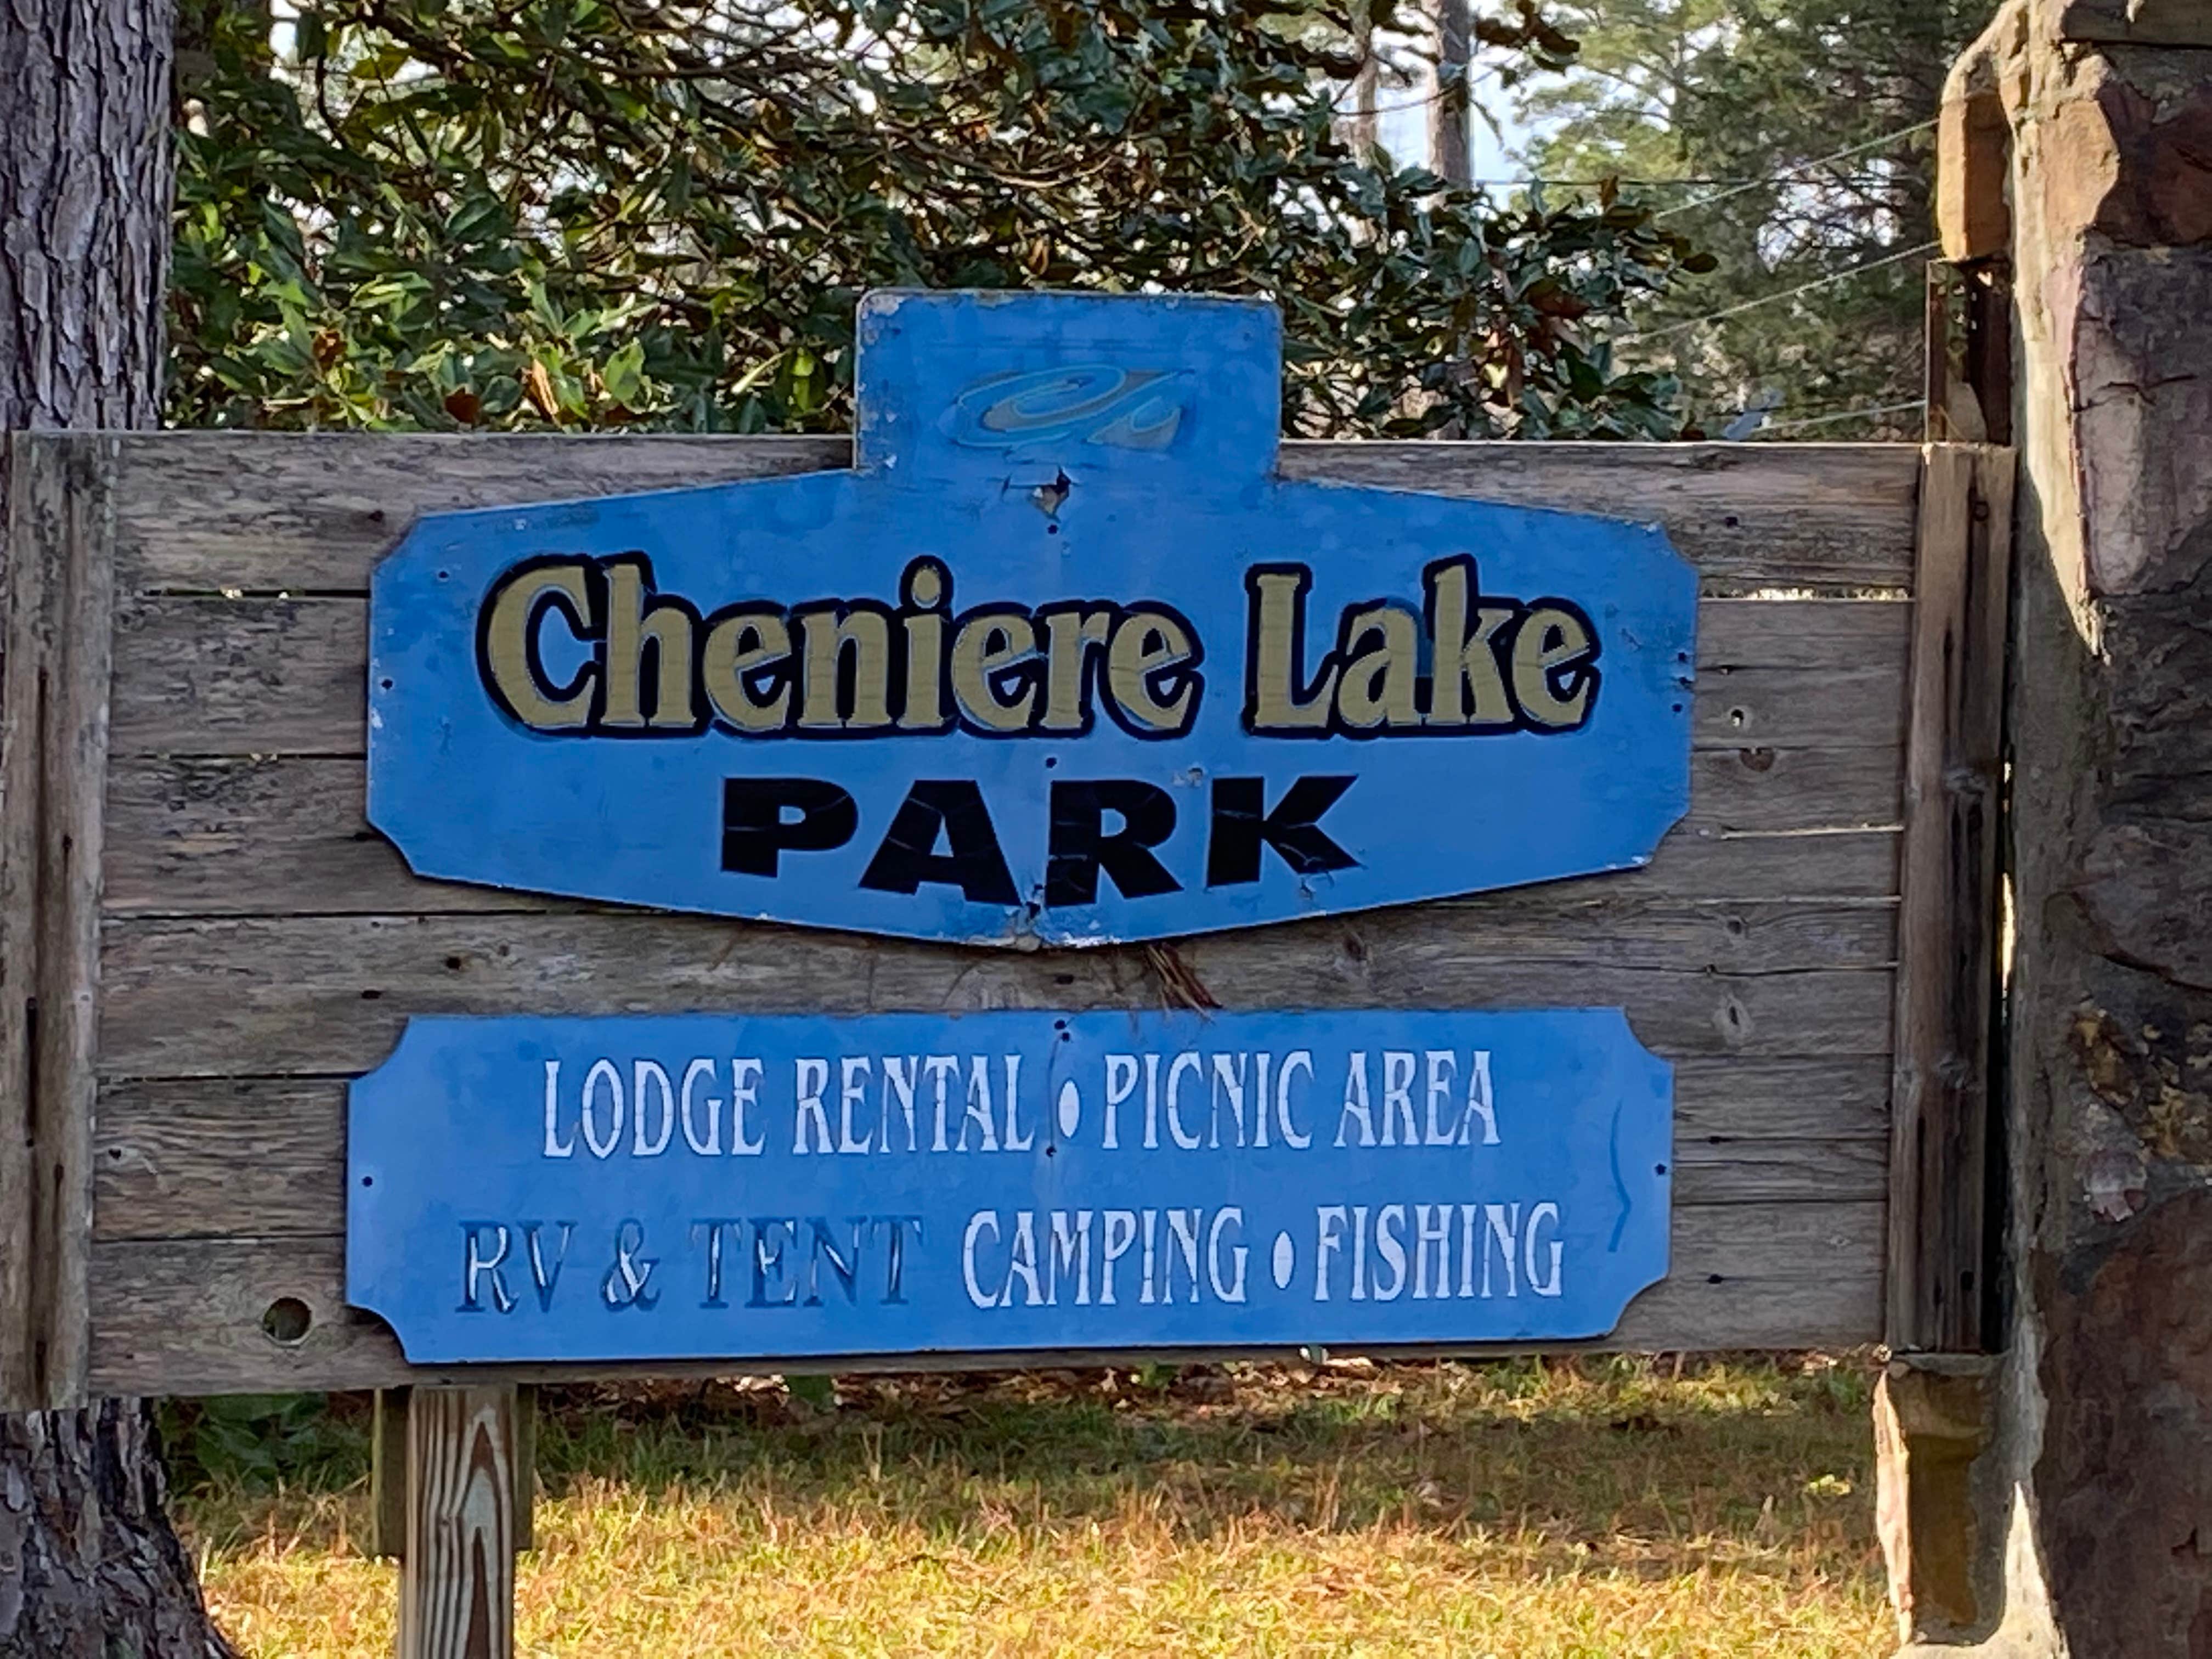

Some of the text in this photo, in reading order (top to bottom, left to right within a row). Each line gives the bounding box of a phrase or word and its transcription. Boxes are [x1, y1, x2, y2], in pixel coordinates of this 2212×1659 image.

[476, 551, 1601, 738] Cheniere Lake
[721, 775, 1358, 907] PARK
[543, 1049, 1501, 1159] LODGE RENTAL PICNIC AREA
[455, 1201, 1563, 1313] RV & TENT CAMPING FISHING
